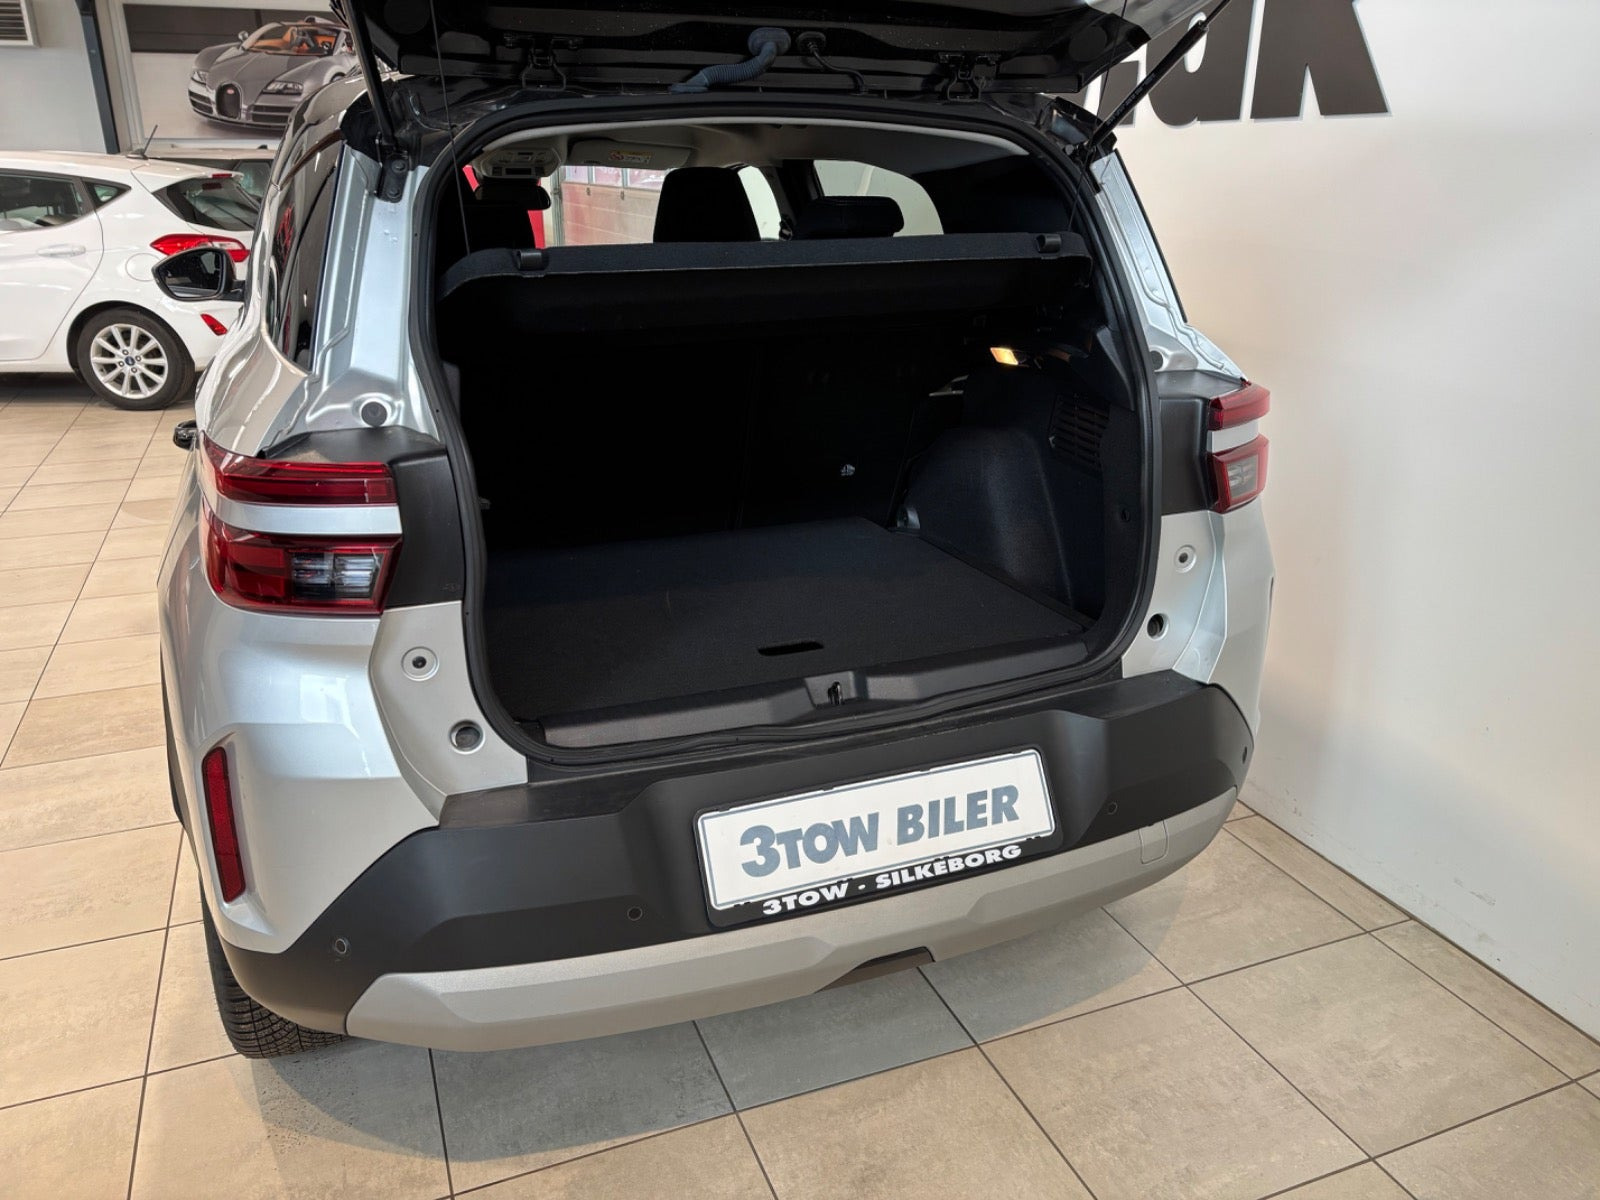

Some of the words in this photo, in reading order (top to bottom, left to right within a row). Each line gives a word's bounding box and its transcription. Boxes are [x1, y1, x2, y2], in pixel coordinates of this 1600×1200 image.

[740, 812, 880, 877] 3TOW
[896, 785, 1019, 846] BILER
[762, 883, 849, 915] 3TOW
[875, 845, 1022, 889] SILKEBORG
